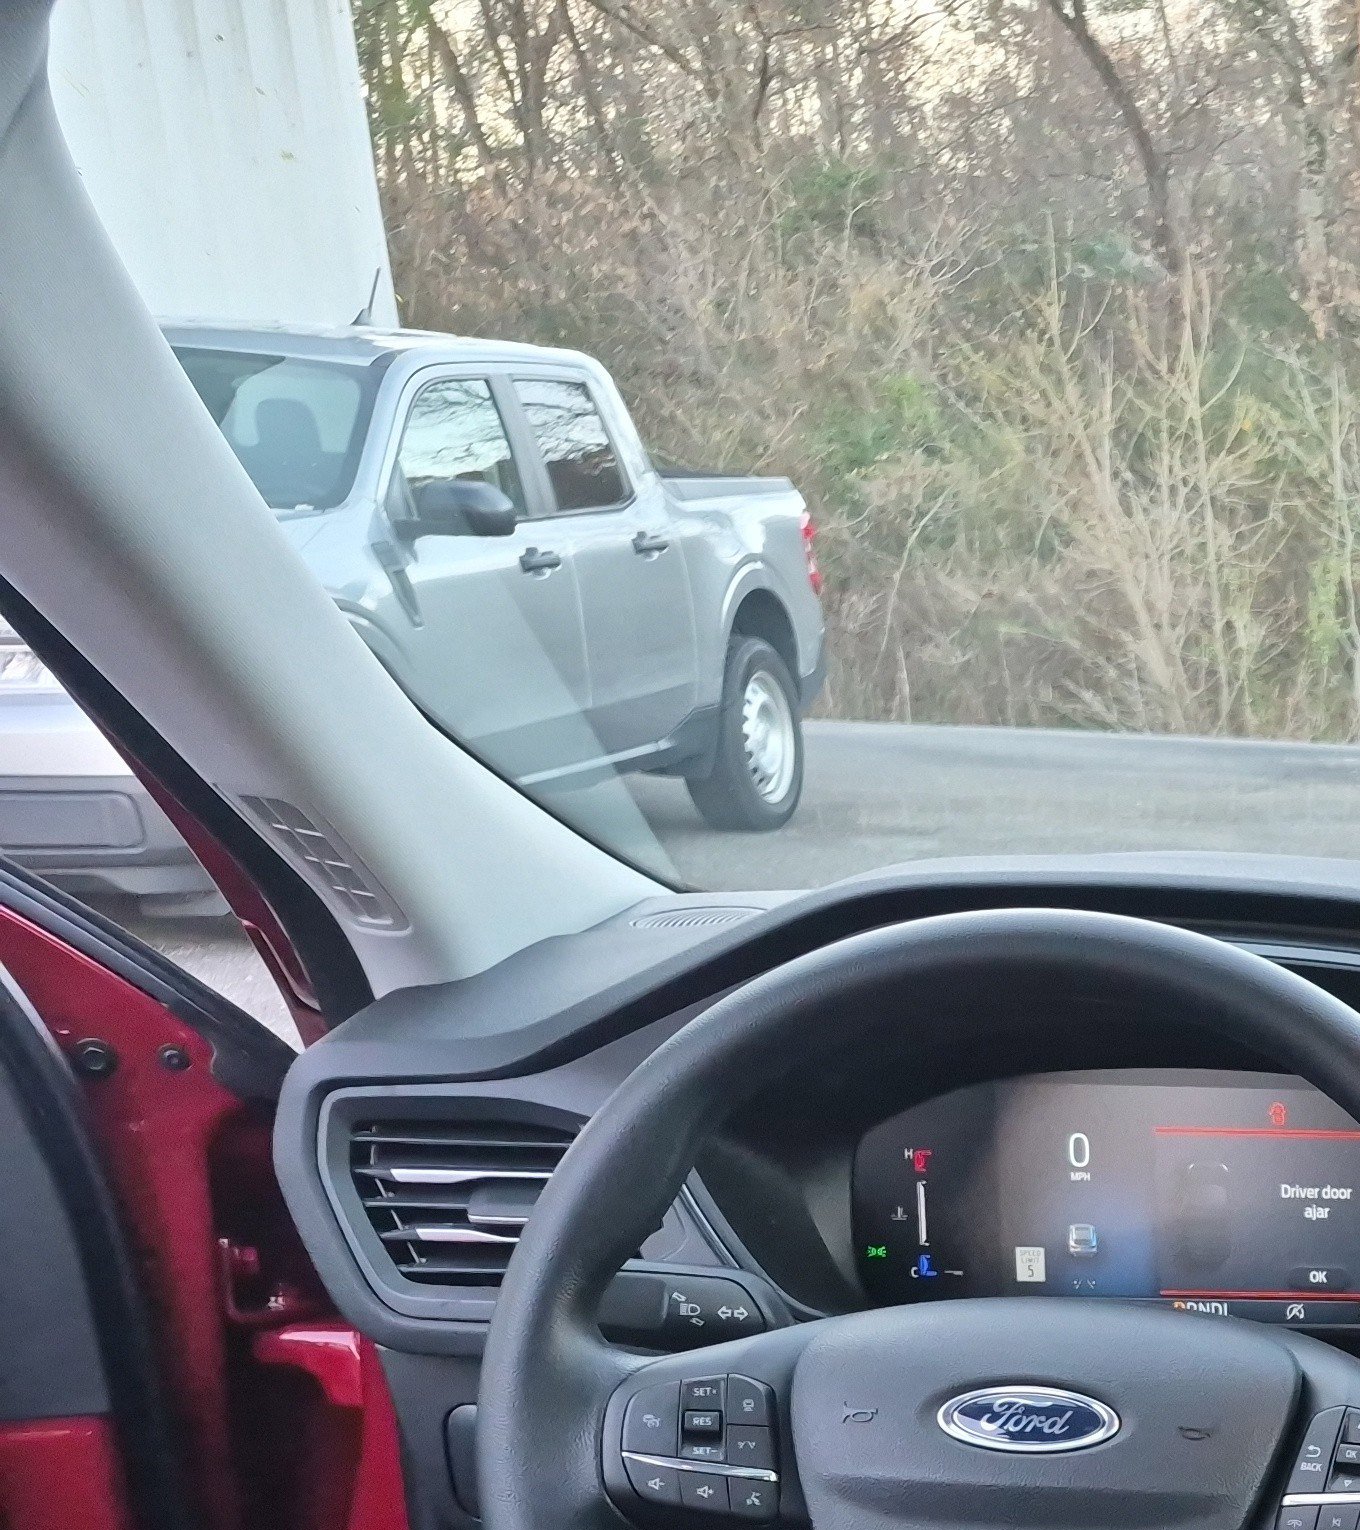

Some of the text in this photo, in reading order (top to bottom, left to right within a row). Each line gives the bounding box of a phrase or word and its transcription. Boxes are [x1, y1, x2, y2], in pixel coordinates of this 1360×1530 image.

[904, 1148, 913, 1160] H
[1069, 1132, 1090, 1168] 0
[1070, 1171, 1091, 1181] MPH
[1280, 1183, 1353, 1200] Driver door
[1304, 1203, 1331, 1221] ajar
[1027, 1264, 1035, 1278] 5
[1309, 1270, 1328, 1283] OK
[692, 1416, 713, 1427] RES
[980, 1397, 1074, 1435] Ford
[1345, 1449, 1358, 1459] OK
[1300, 1462, 1322, 1472] BACK
